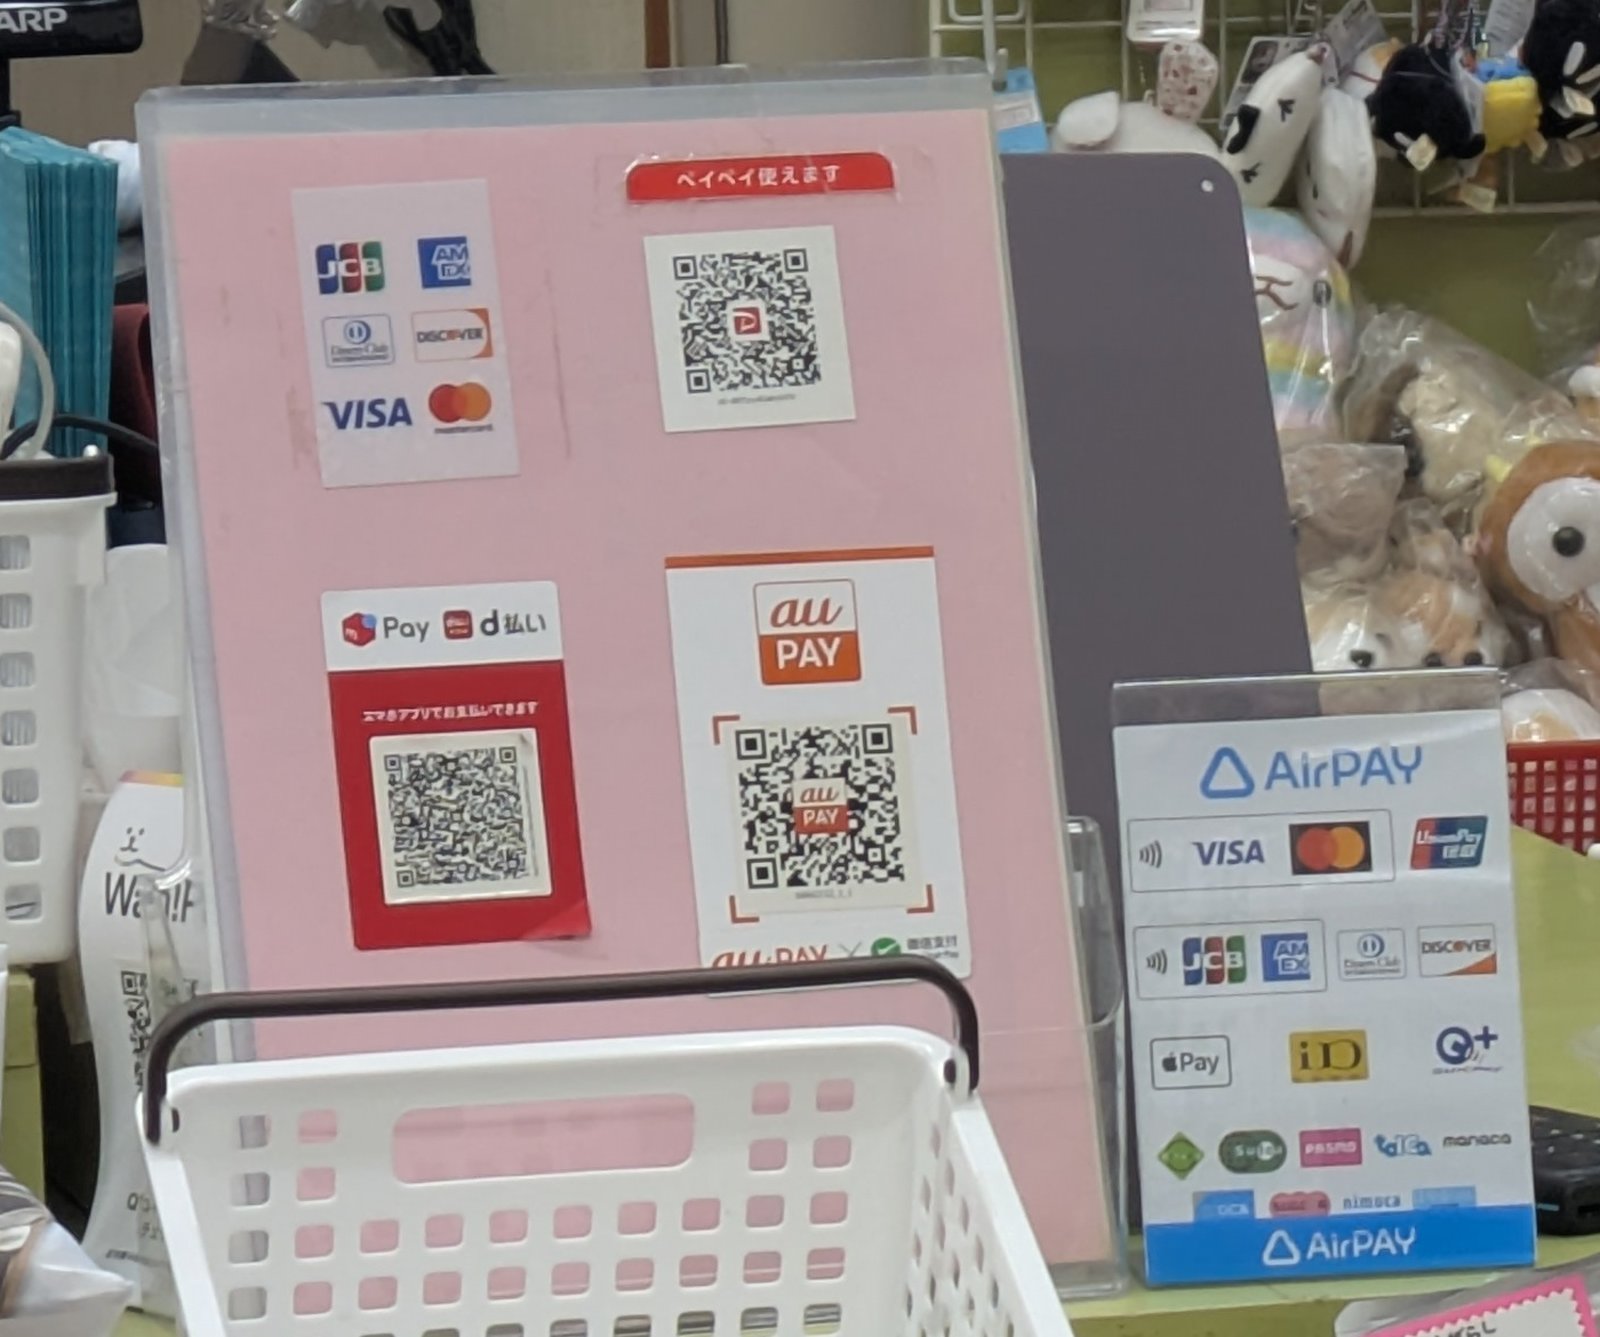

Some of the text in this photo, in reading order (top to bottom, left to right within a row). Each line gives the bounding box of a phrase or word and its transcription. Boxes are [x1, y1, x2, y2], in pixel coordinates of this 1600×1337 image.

[677, 165, 840, 189] ペイペイ使えます
[317, 258, 382, 278] JCB
[416, 328, 484, 343] DISCOVER
[321, 398, 413, 430] VISA
[480, 609, 547, 637] d払い
[770, 598, 843, 628] au
[383, 616, 430, 642] Pay
[776, 637, 841, 670] PAY
[1264, 745, 1423, 790] AirPAY
[800, 787, 840, 803] au
[803, 808, 838, 826] PAY
[1192, 839, 1266, 866] VISA
[1421, 938, 1492, 954] DISCOVER
[1184, 951, 1245, 970] JCB
[1180, 1052, 1219, 1075] Pay
[1299, 1038, 1362, 1071] iD
[1304, 1141, 1357, 1155] PASMO
[1443, 1133, 1512, 1147] manaca
[1343, 1194, 1402, 1209] nimoca
[1307, 1227, 1416, 1260] AirPAY
